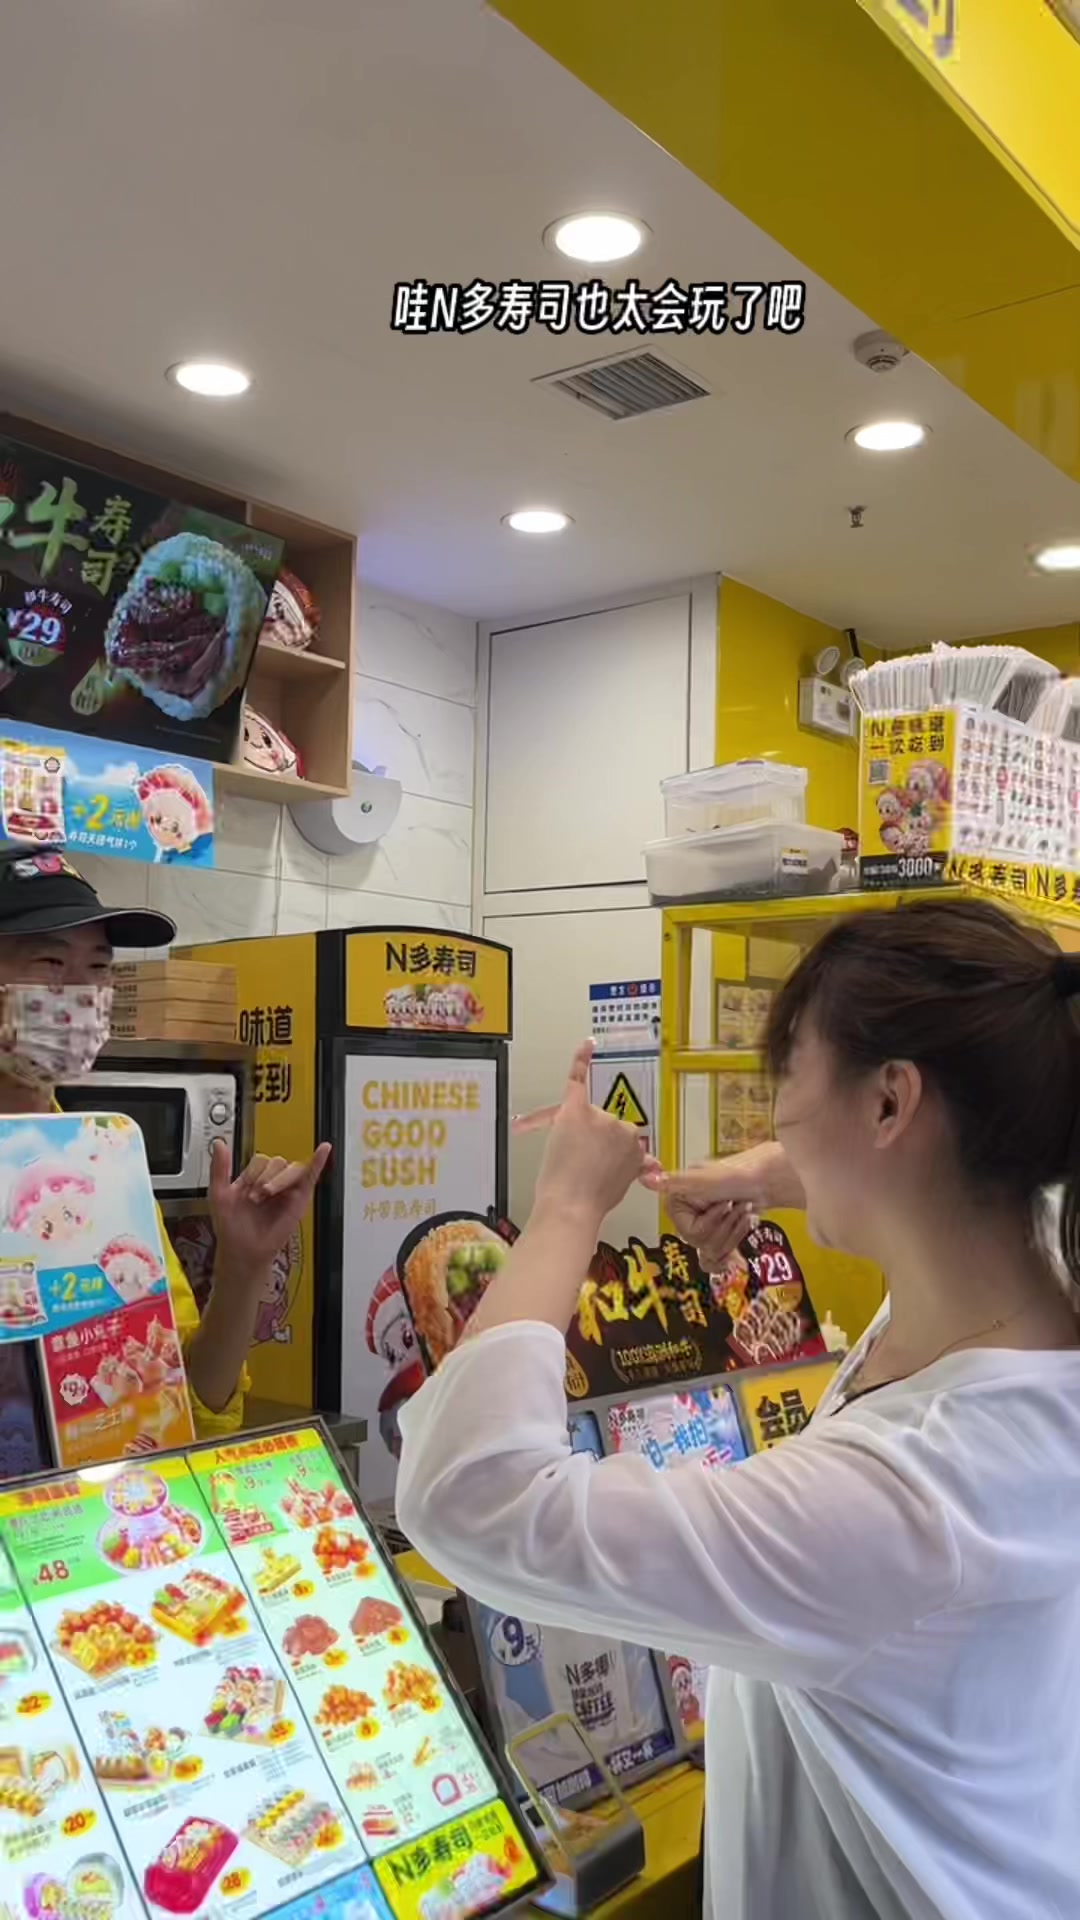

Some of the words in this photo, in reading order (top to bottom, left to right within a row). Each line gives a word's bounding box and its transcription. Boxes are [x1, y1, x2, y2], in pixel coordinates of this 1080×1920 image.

[0, 477, 88, 577] 牛
[386, 942, 476, 977] N多寿司
[362, 1081, 480, 1111] CHINESE
[362, 1119, 446, 1148] GOOD
[361, 1157, 437, 1188] SUSH
[385, 1824, 472, 1887] N多寿司
